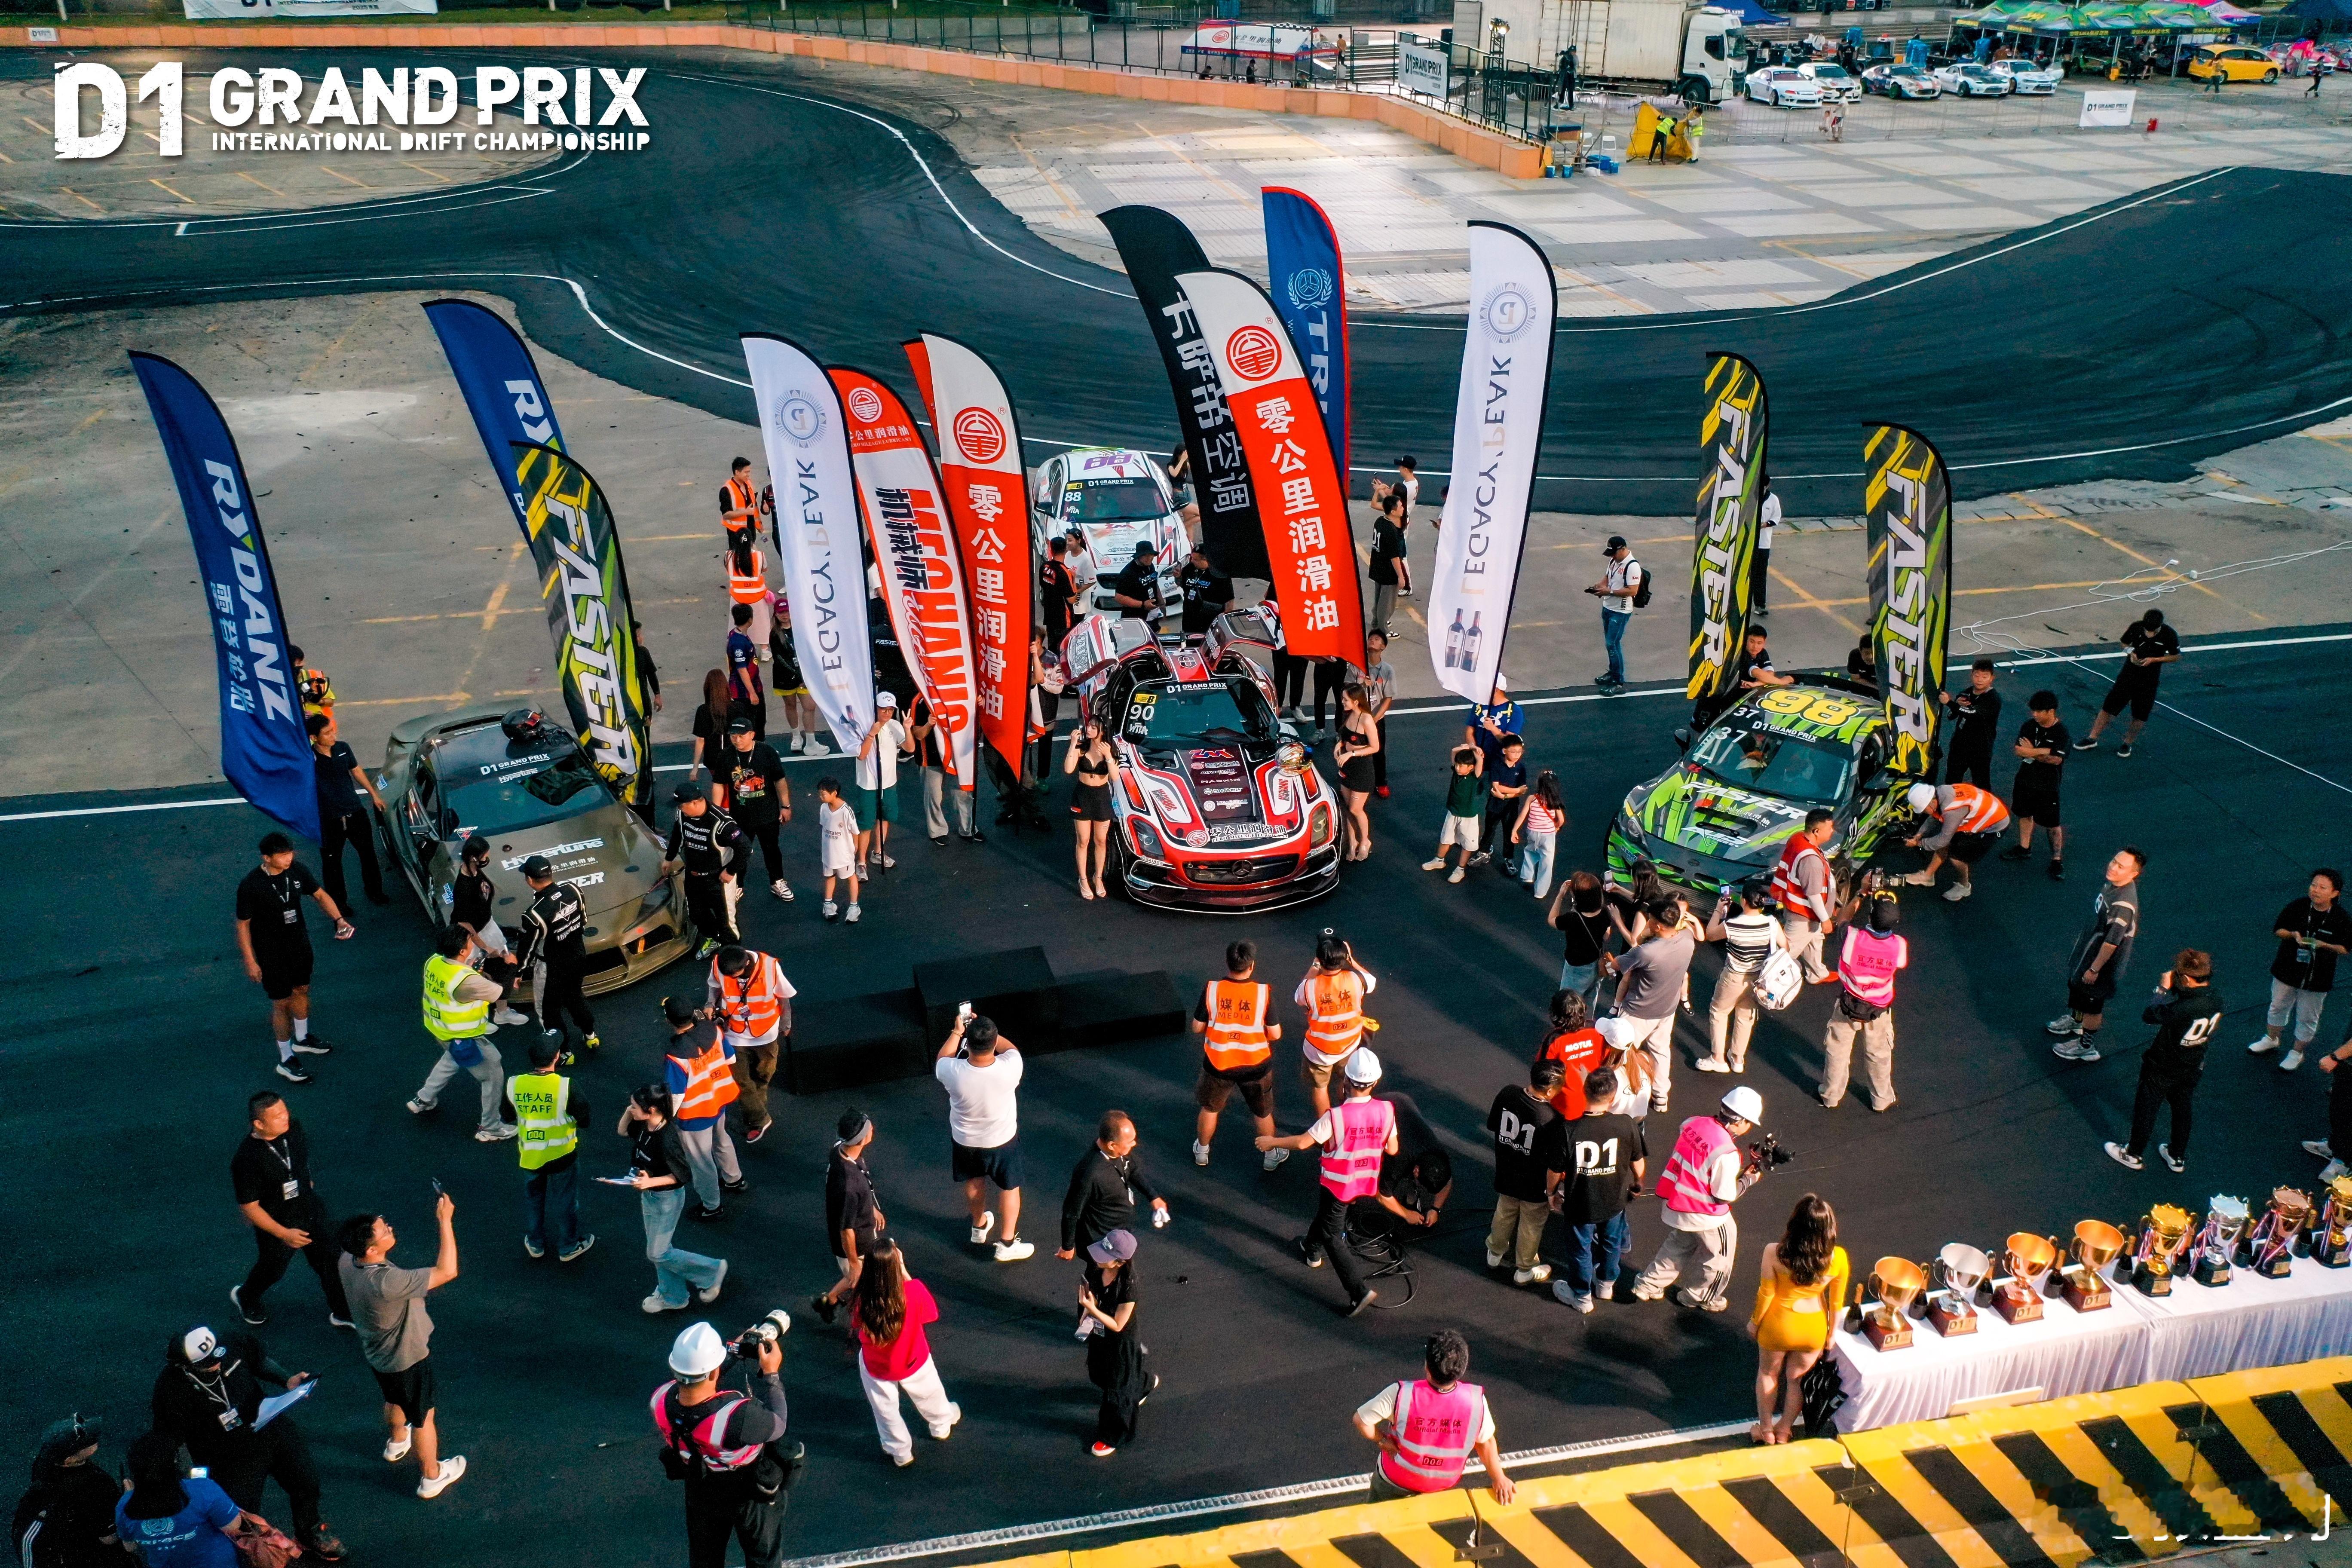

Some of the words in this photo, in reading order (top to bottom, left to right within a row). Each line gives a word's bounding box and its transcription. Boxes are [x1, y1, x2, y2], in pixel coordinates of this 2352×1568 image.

[1406, 53, 1412, 74] D1
[1428, 61, 1442, 77] PRIX
[1064, 492, 1081, 502] 88
[1256, 396, 1339, 631] 零公里润滑油
[875, 488, 928, 589] 机械师
[1702, 400, 1751, 672] FASTER
[204, 458, 295, 726] RYDANZ
[968, 484, 1007, 720] 零公里润滑油
[1886, 468, 1928, 743] FASTER
[544, 493, 637, 776] FASTER
[1167, 685, 1181, 693] D1
[1130, 705, 1154, 720] 90
[1733, 707, 1759, 718] 37
[1757, 689, 1860, 727] 98
[1715, 726, 1748, 743] 37
[1752, 720, 1768, 730] D1
[1770, 725, 1797, 737] GRAND
[1797, 732, 1818, 742] PRIX
[481, 764, 498, 775] D1
[498, 757, 527, 768] GRAND
[1680, 781, 1808, 820] FASTER
[1320, 989, 1352, 1004] 媒体
[1220, 998, 1251, 1012] 媒体
[1320, 1002, 1353, 1012] MEDIA
[1218, 1012, 1250, 1020] MEDIA
[2184, 1012, 2220, 1040] D1
[1565, 1040, 1593, 1053] MOTUL
[516, 1093, 553, 1103] 工作人员
[518, 1105, 552, 1114] STAFF
[1501, 1108, 1535, 1149] D1
[1576, 1138, 1618, 1169] D1
[1355, 1159, 1368, 1168] 003
[2086, 1295, 2100, 1305] D1
[2017, 1307, 2030, 1317] D1
[1949, 1320, 1963, 1329] D1
[198, 1336, 212, 1353] D1
[1885, 1334, 1899, 1344] D1
[1415, 1417, 1461, 1427] 官方媒体
[1414, 1426, 1438, 1434] Official
[1423, 1456, 1442, 1466] 006
